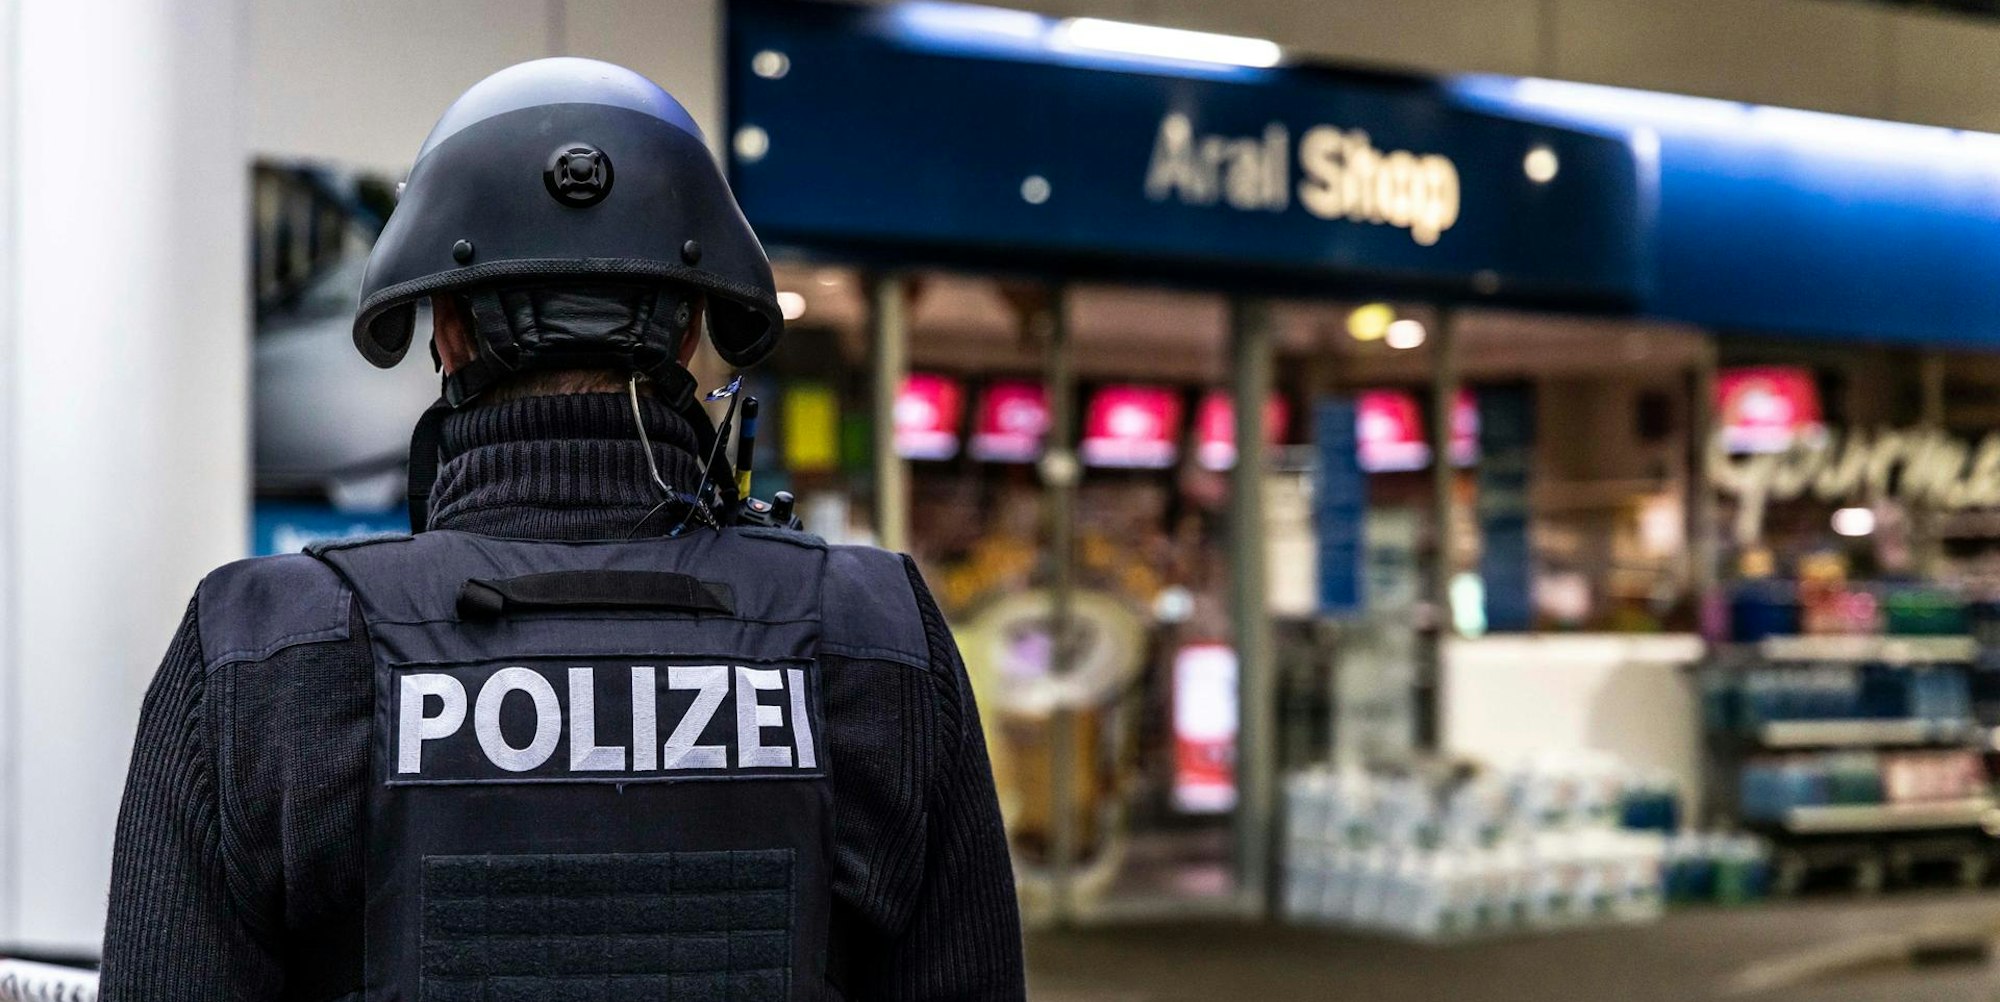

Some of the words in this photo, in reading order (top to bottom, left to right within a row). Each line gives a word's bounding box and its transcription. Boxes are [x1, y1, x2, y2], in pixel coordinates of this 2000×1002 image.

[1146, 112, 1290, 212] Aral
[1299, 124, 1461, 246] Shop
[398, 665, 817, 774] POLIZEI
